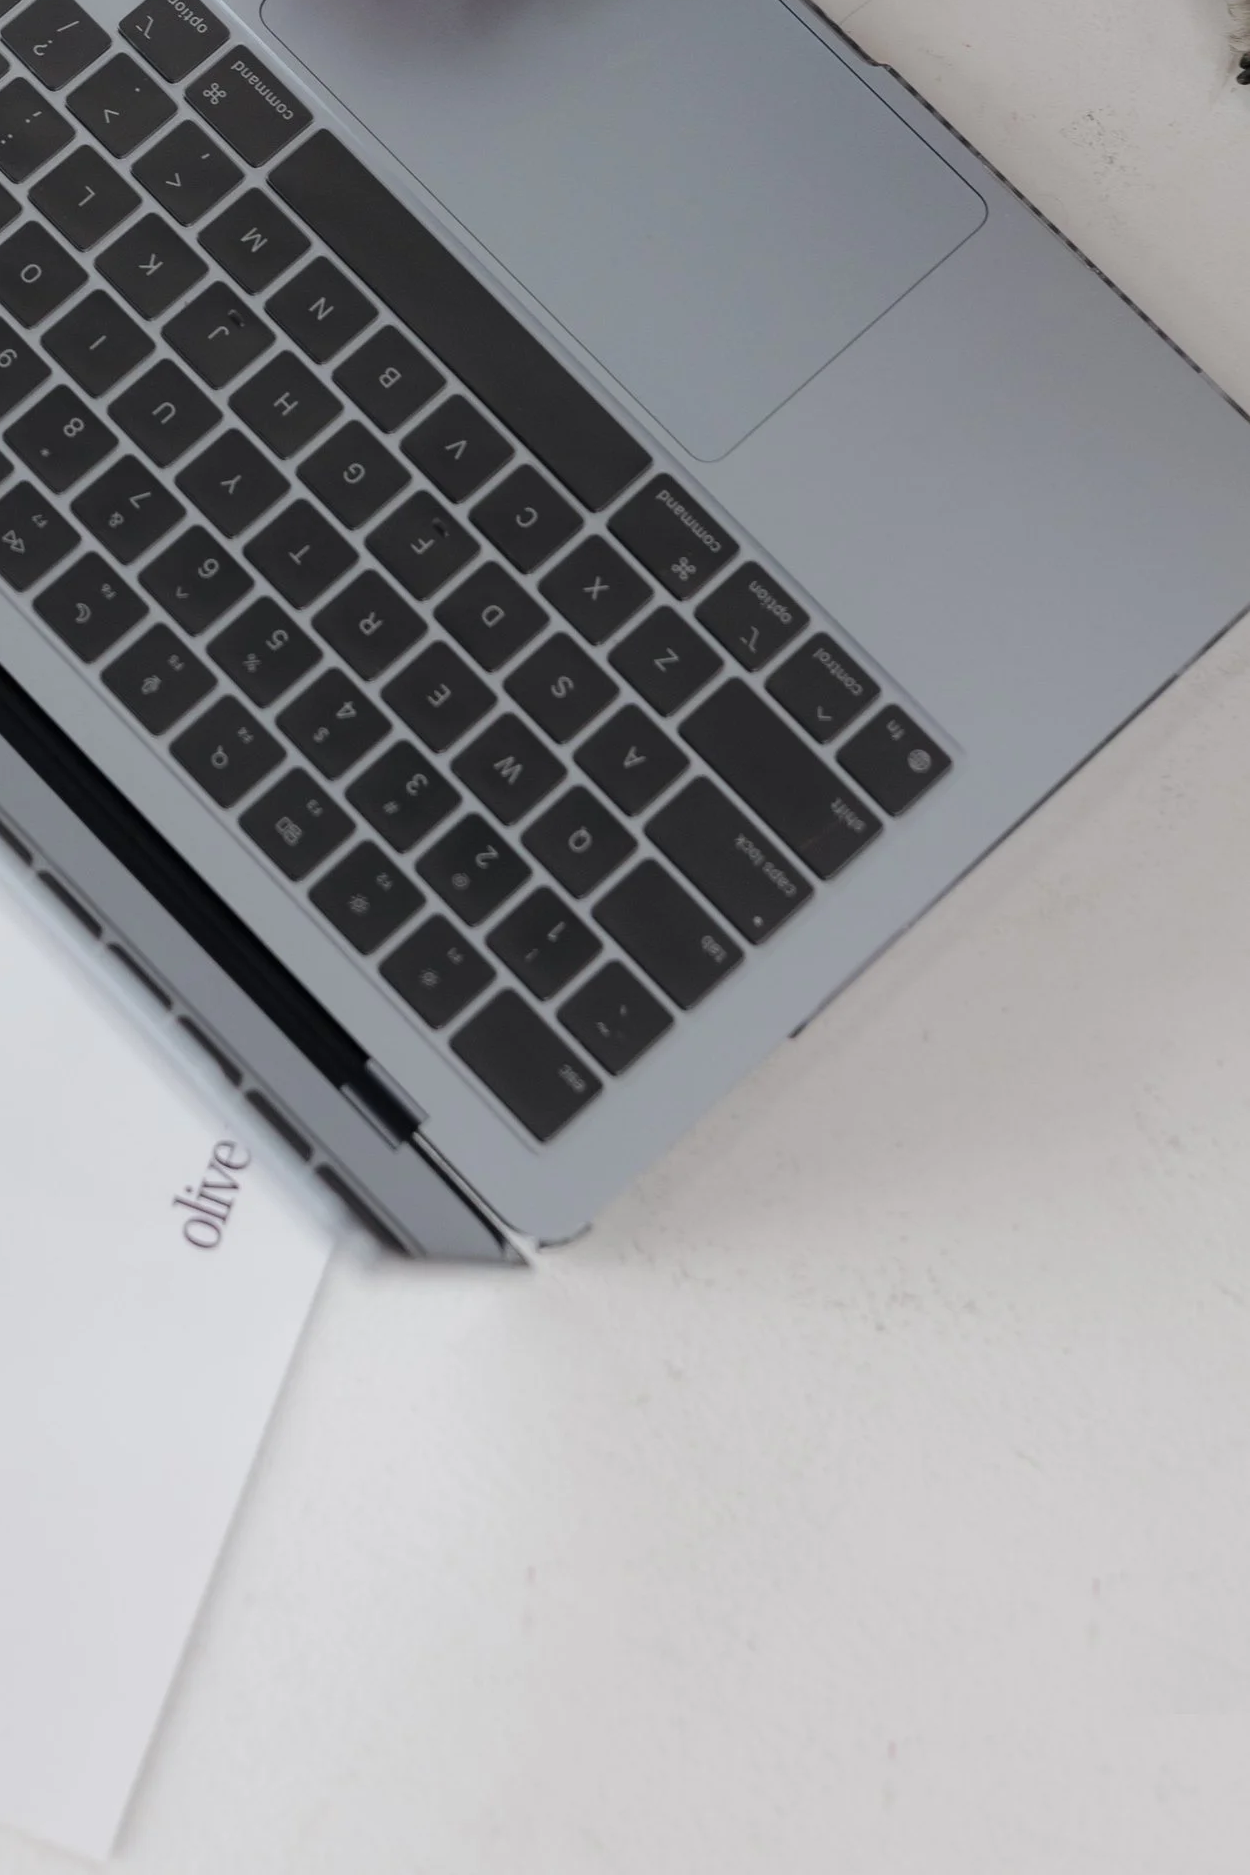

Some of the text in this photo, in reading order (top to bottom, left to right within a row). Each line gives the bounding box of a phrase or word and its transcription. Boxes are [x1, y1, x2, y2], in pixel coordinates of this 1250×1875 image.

[229, 59, 295, 122] command
[77, 184, 97, 208] L
[239, 226, 269, 254] M
[19, 262, 44, 285] O
[137, 252, 165, 277] K
[307, 295, 335, 322] N
[377, 366, 403, 390] B
[150, 400, 177, 425] U
[272, 390, 300, 417] H
[444, 438, 468, 461] V
[219, 473, 243, 496] Y
[342, 461, 367, 485] G
[514, 505, 539, 529] C
[654, 488, 723, 554] command
[409, 537, 436, 556] F
[196, 557, 221, 580] 6
[582, 575, 611, 602] X
[747, 579, 794, 625] option
[358, 610, 384, 637] R
[480, 603, 506, 629] D
[264, 628, 290, 652] 5
[652, 646, 680, 673] Z
[811, 646, 864, 697] control
[426, 682, 453, 708] E
[549, 674, 575, 699] S
[885, 719, 905, 742] fn
[492, 754, 524, 785] W
[622, 745, 647, 769] A
[404, 772, 429, 797] 3
[830, 797, 866, 833] shift
[567, 825, 593, 854] Q
[474, 843, 500, 869] 2
[700, 934, 728, 964] tab
[559, 1063, 587, 1093] esc
[173, 1138, 252, 1249] olive
